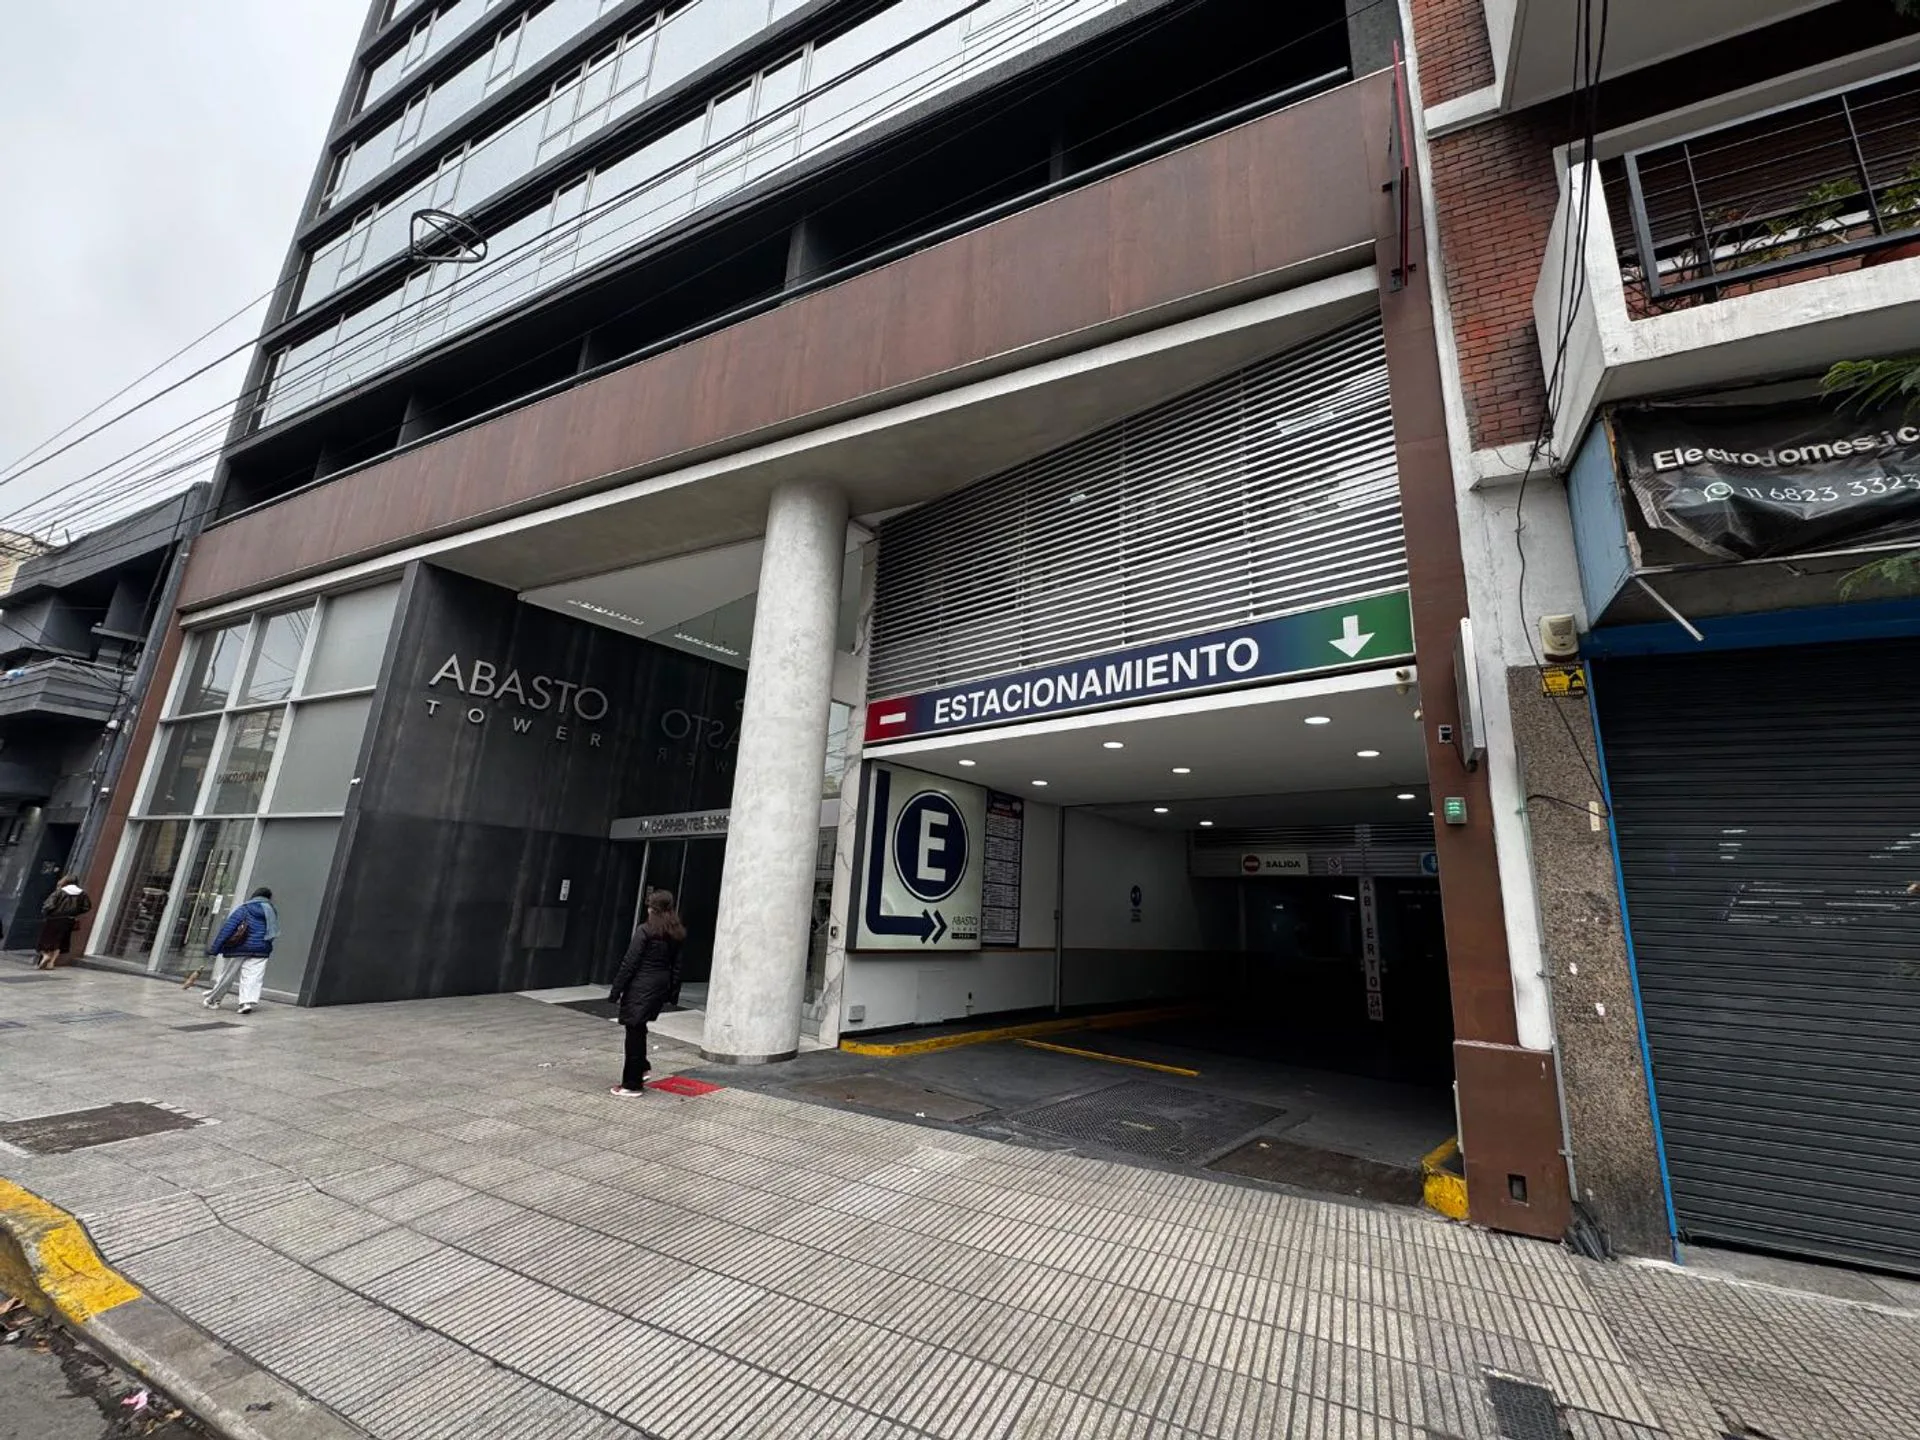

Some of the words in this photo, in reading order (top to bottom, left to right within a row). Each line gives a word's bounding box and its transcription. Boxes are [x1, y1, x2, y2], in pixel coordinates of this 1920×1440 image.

[1742, 486, 1763, 498] 11
[1769, 486, 1838, 501] 6823
[1847, 473, 1920, 496] 3323
[428, 653, 608, 720] ABASTO
[933, 637, 1259, 725] ESTACIONAMIENTO
[426, 699, 601, 747] TOWER
[917, 808, 949, 882] E
[1265, 860, 1301, 869] SALIDA
[1362, 880, 1379, 987] ABIERTO
